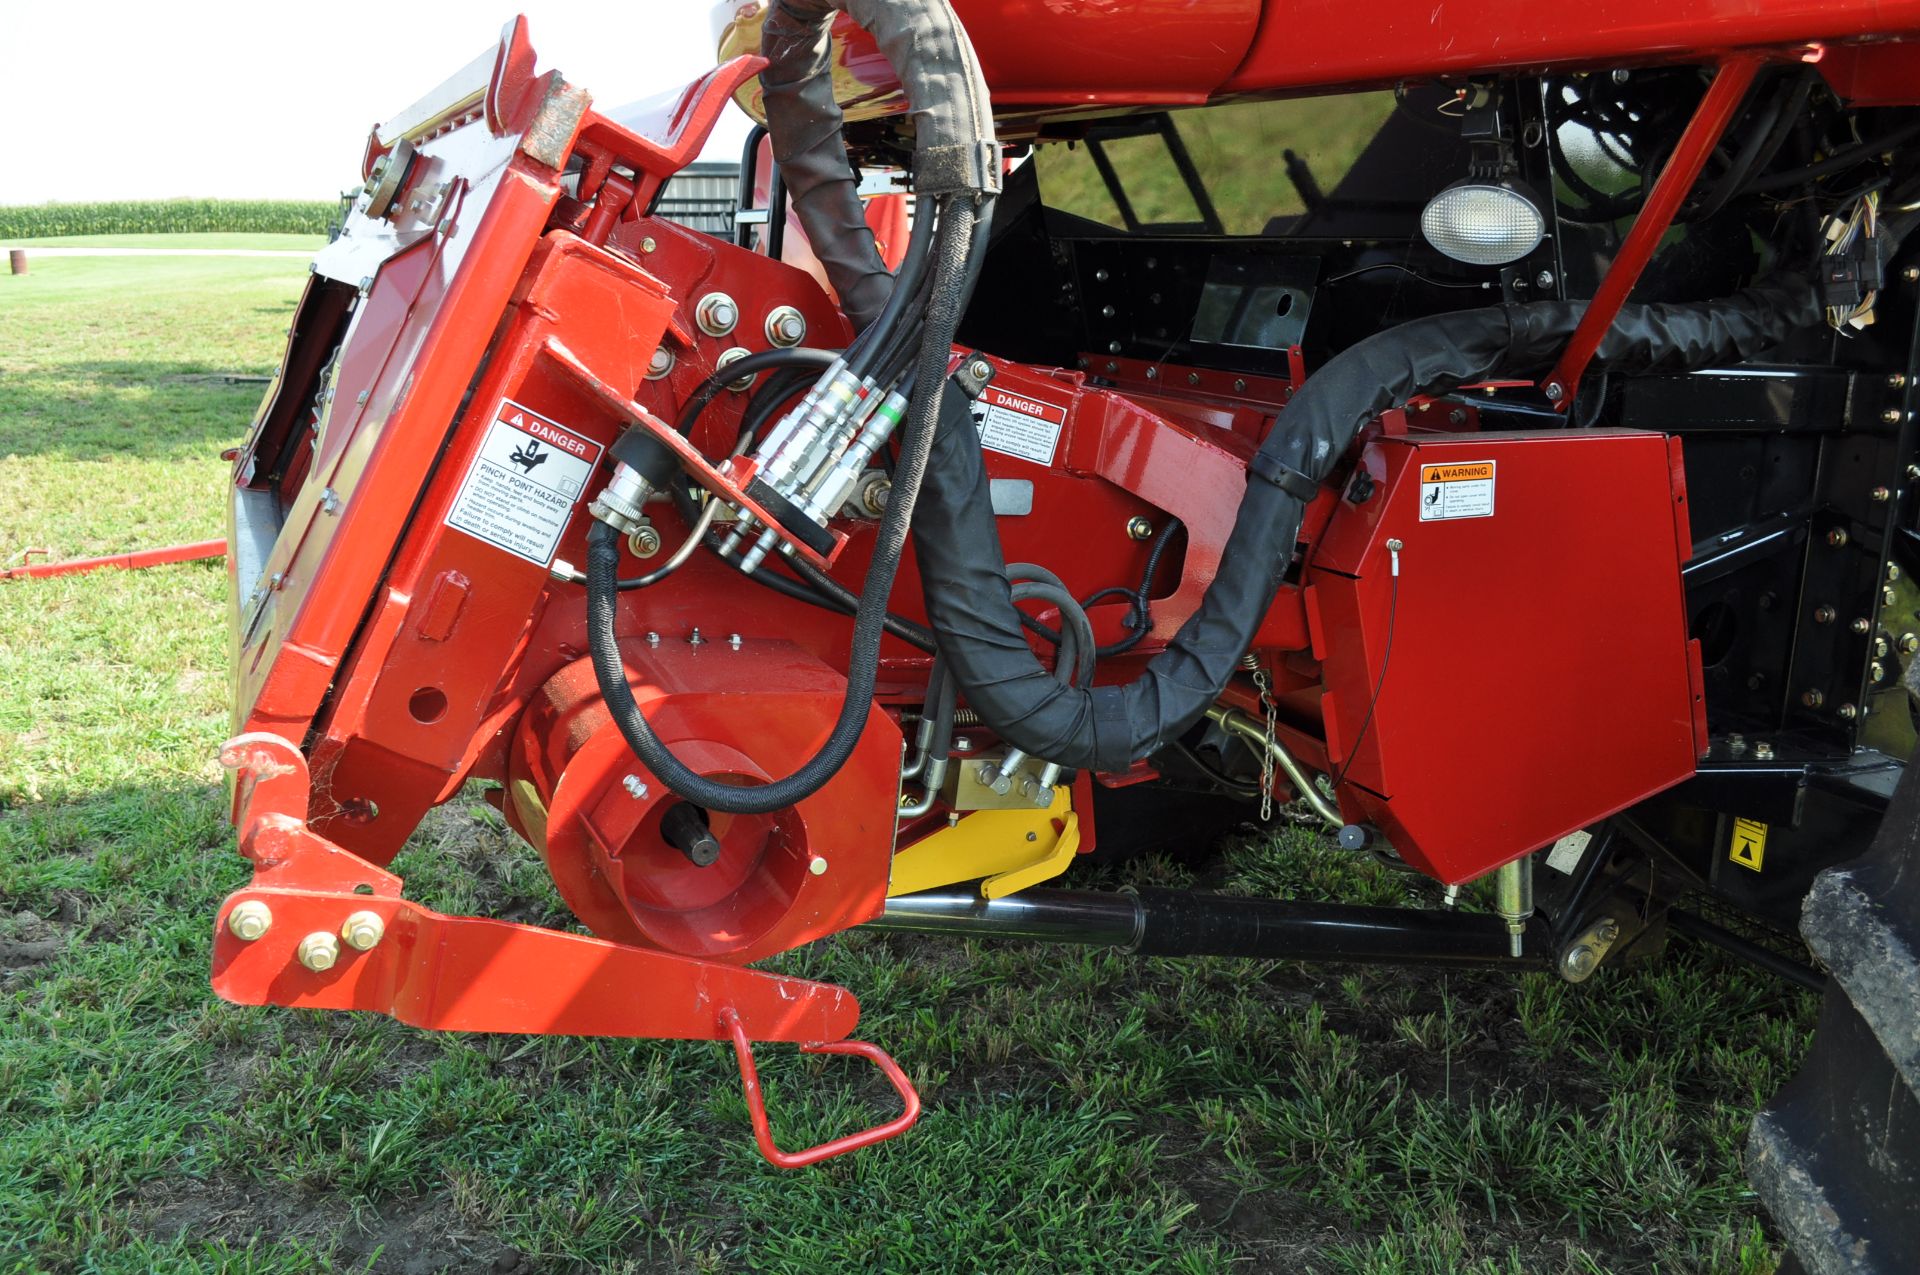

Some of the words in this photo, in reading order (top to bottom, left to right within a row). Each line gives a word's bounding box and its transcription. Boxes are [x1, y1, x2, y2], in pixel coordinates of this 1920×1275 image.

[996, 393, 1043, 415] DANGER
[529, 421, 586, 455] DANGER
[1442, 466, 1487, 478] WARNING
[479, 463, 506, 480] PINCH
[508, 476, 533, 493] POINT
[533, 488, 568, 508] HAZARD
[483, 490, 494, 498] NOT
[522, 493, 532, 501] and
[532, 498, 545, 507] body
[546, 505, 558, 513] away
[458, 508, 481, 521] Failure
[489, 522, 513, 536] comply
[514, 532, 526, 541] will
[526, 537, 544, 549] result
[463, 518, 481, 529] death
[489, 530, 512, 543] serious
